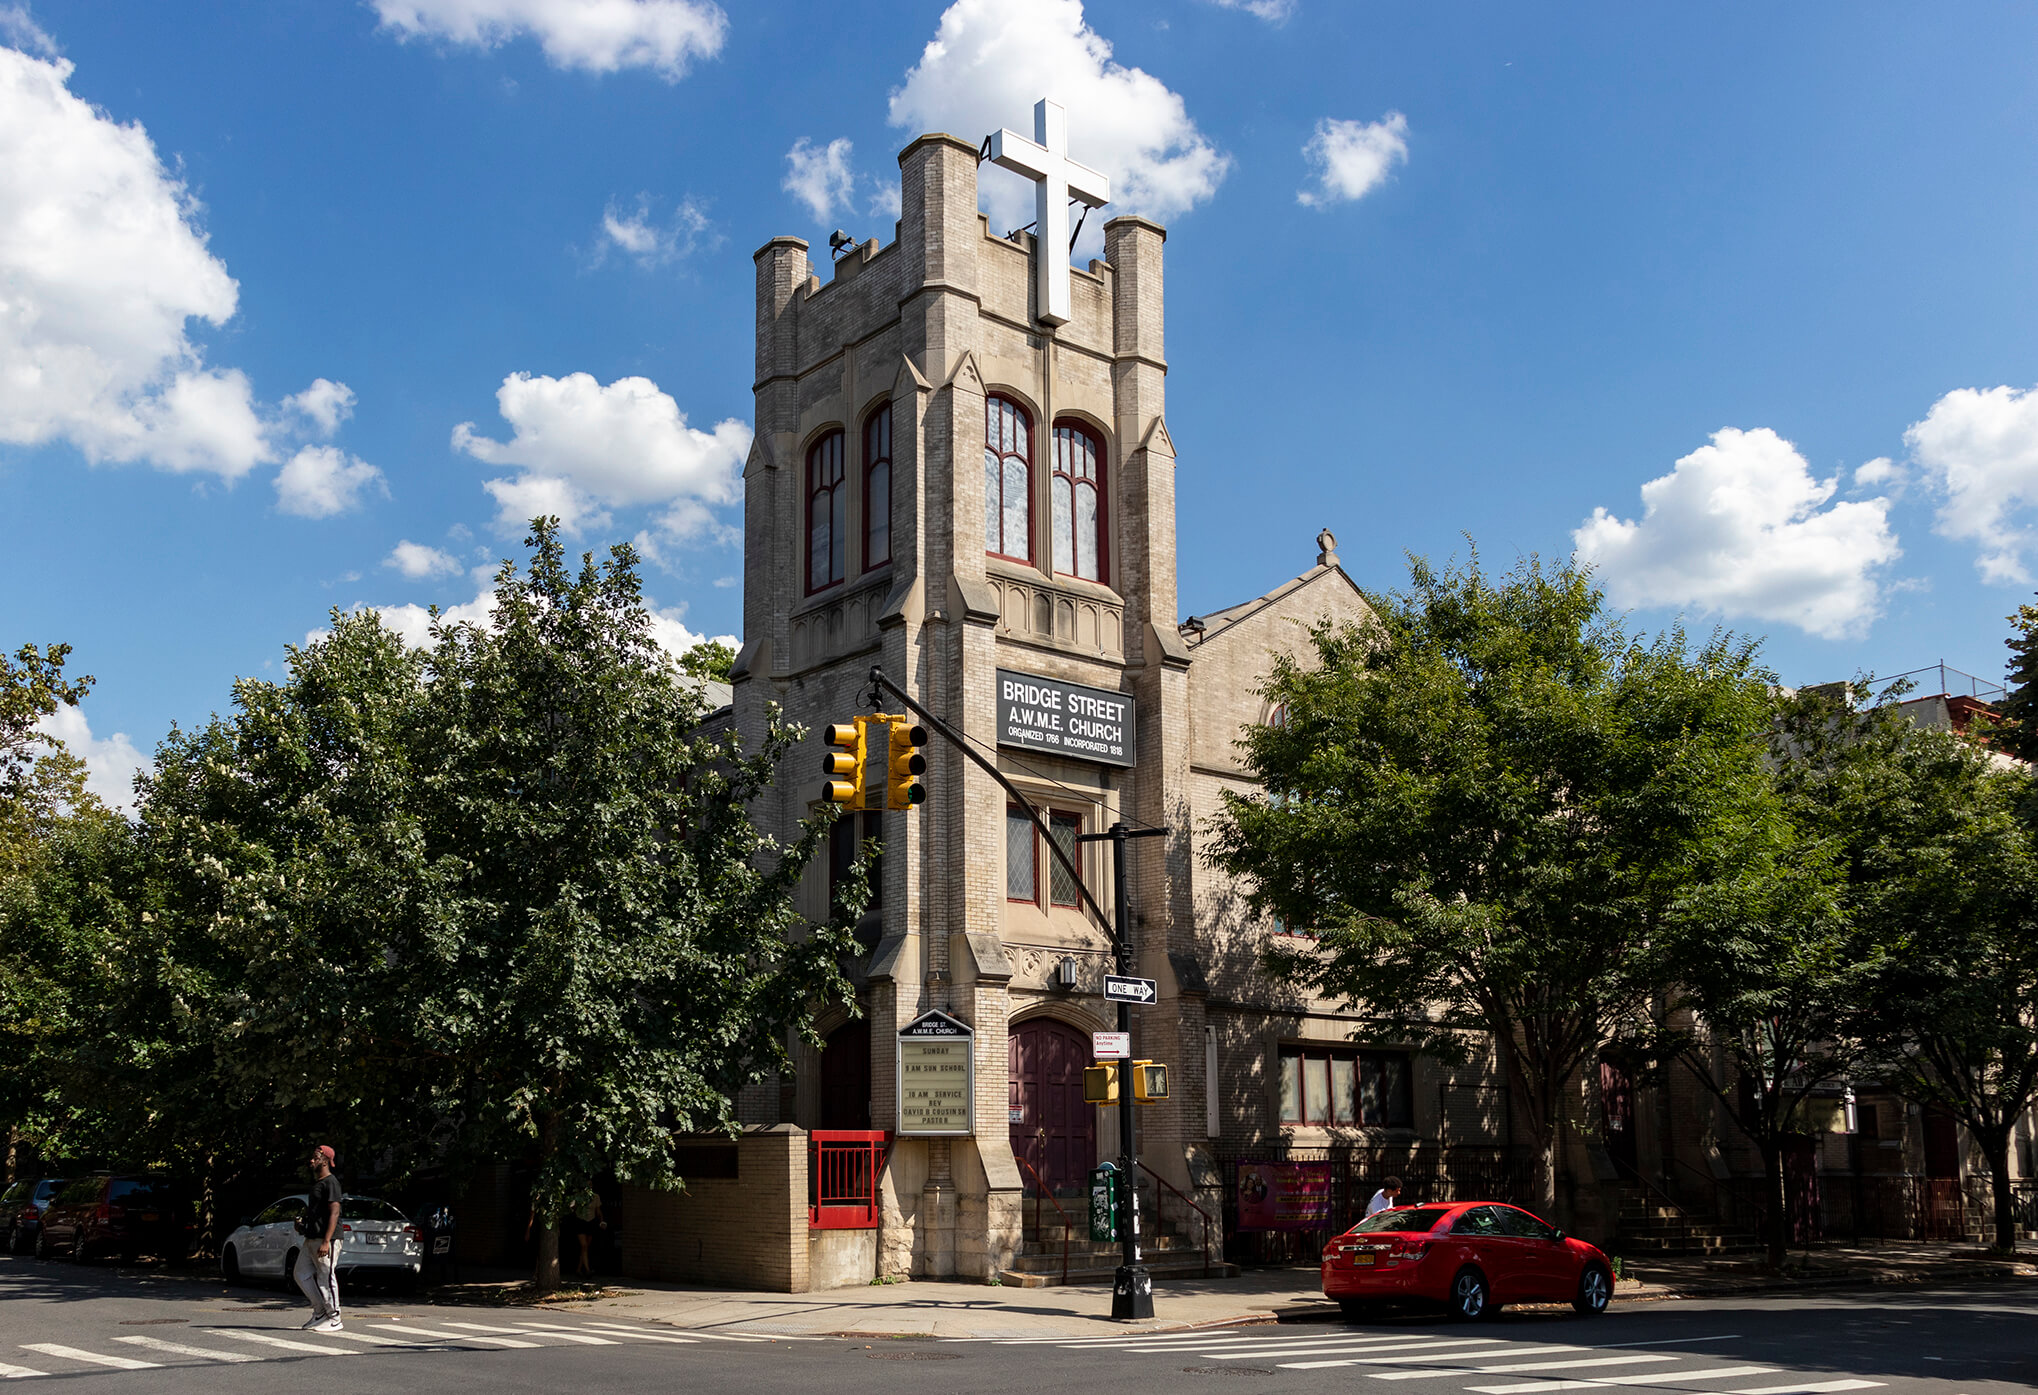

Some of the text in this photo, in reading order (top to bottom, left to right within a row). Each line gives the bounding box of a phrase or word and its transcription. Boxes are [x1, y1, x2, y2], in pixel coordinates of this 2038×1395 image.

[1003, 680, 1125, 722] BRIDGE STREET
[1009, 706, 1122, 743] A.W.M.E. CHURCH
[1008, 725, 1123, 757] ORGANIZED 1766 INCORPORATED 1818
[1112, 983, 1149, 997] ONE WAY
[922, 1047, 950, 1055] SUNDAY
[911, 1064, 921, 1072] AM
[923, 1064, 937, 1072] SUN
[940, 1064, 966, 1072] SCHOOL
